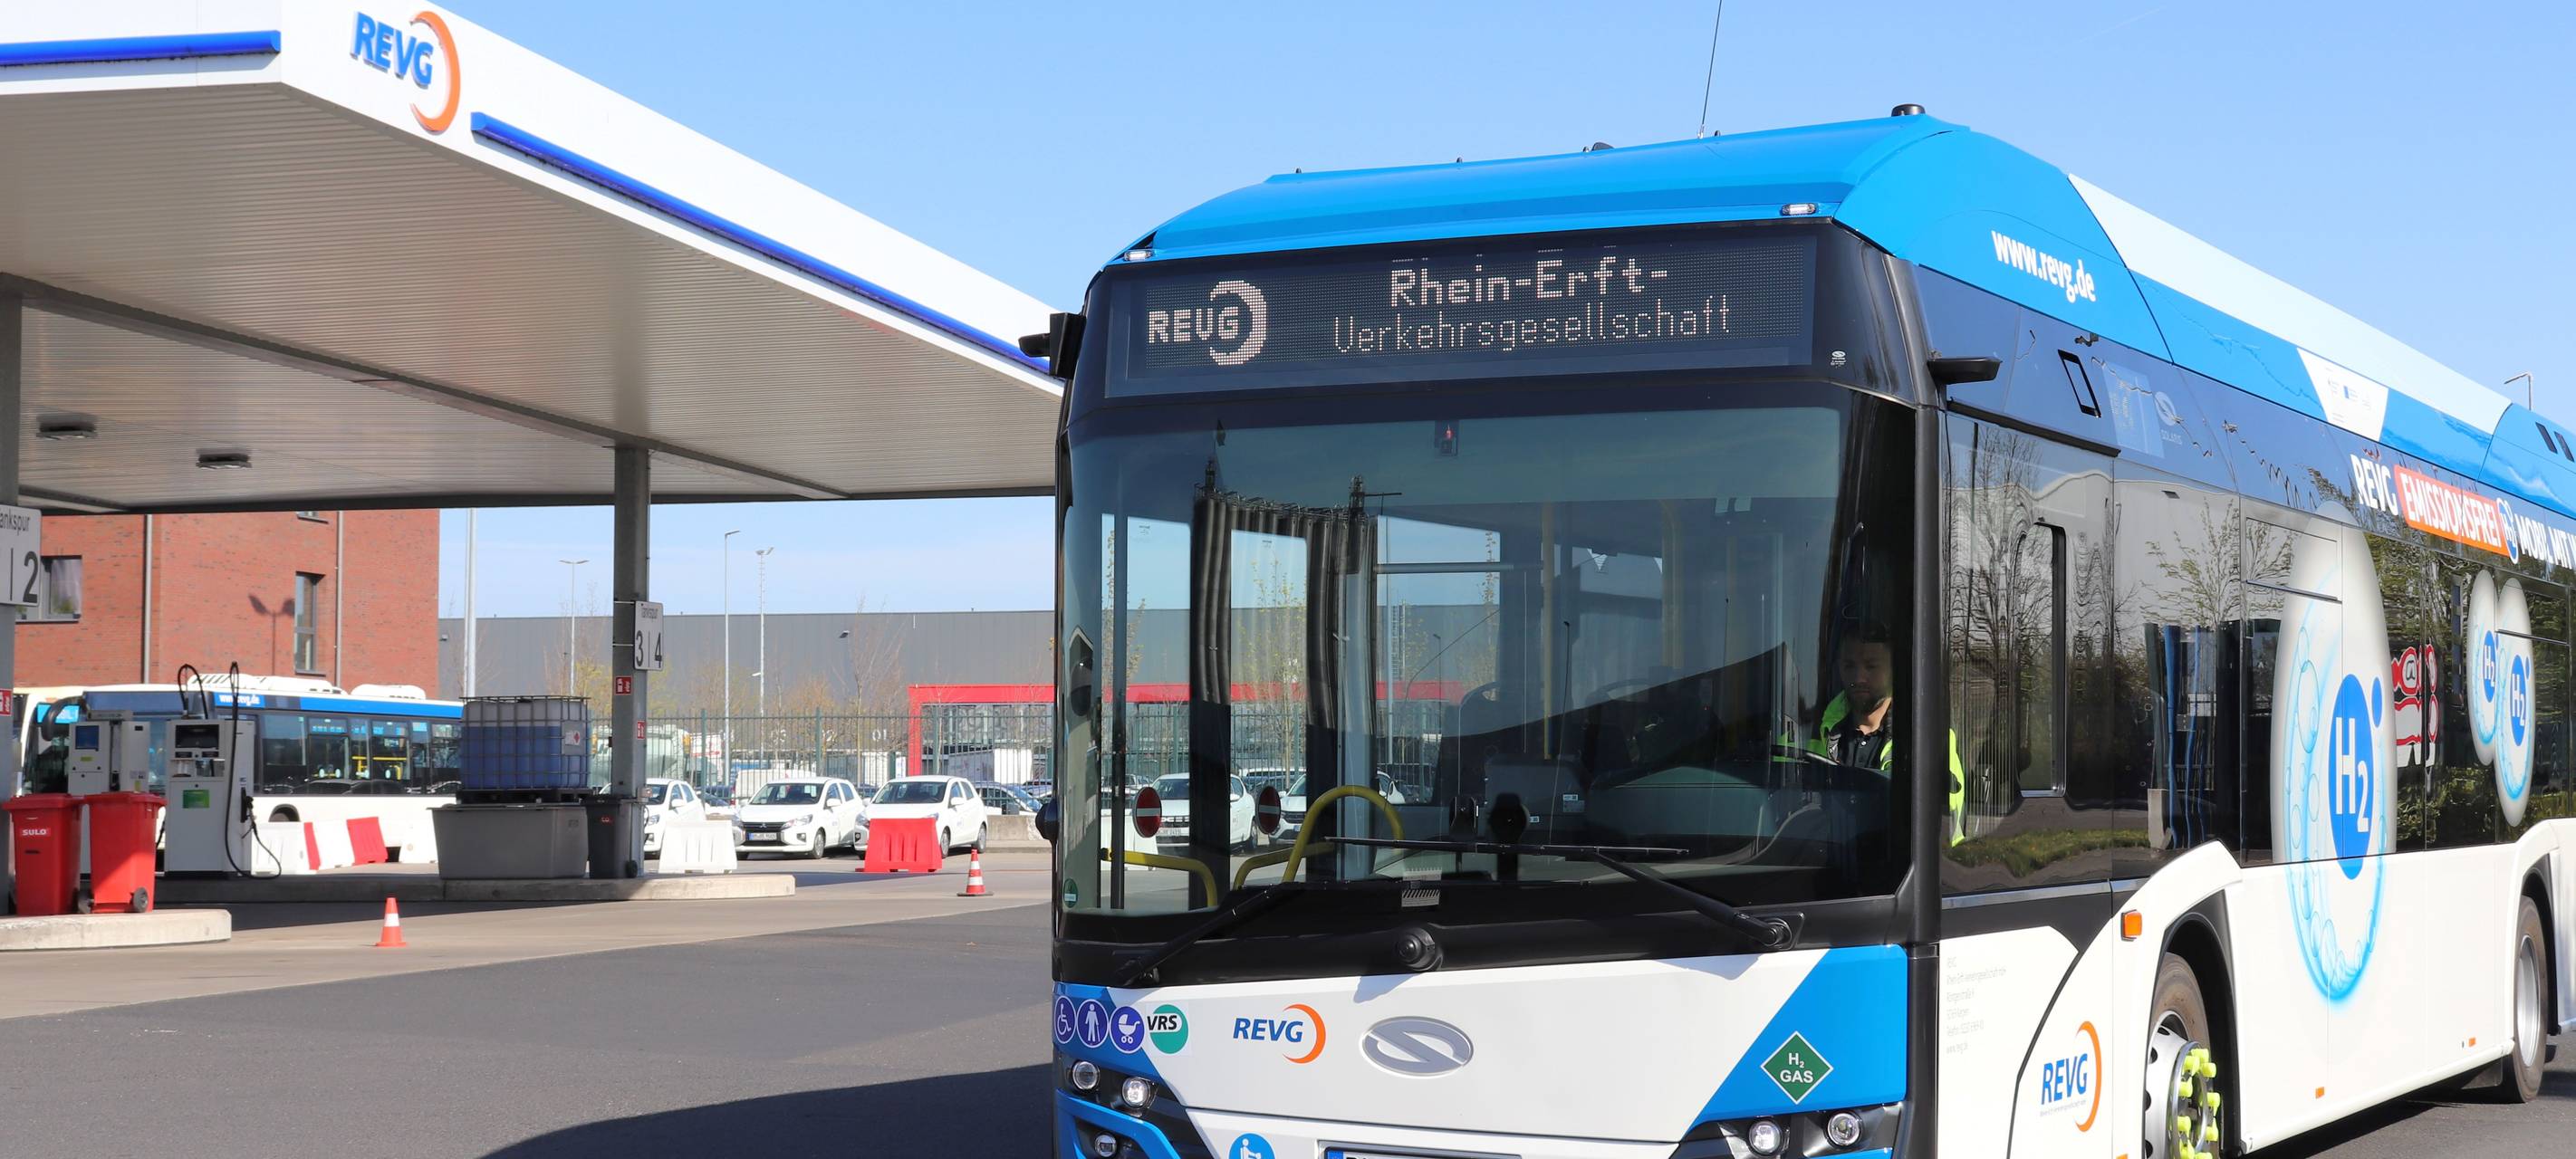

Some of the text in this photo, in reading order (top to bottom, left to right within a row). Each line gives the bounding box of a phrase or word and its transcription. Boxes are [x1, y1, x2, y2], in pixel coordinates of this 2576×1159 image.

[351, 11, 434, 88] REVG
[1391, 254, 1668, 307] Rhein-Erft-
[1991, 230, 2096, 303] www.revg.de
[1149, 306, 1239, 343] REVG
[1333, 294, 1730, 353] Verkehrsgesellschaft
[0, 508, 30, 536] ankspur
[2350, 454, 2398, 516] REVG
[2399, 472, 2502, 548] EMISSIONSFREI
[2514, 513, 2553, 563] MOBIL
[2548, 526, 2572, 570] MIT
[23, 551, 39, 604] 2
[636, 629, 662, 668] 3 4
[2335, 717, 2369, 833] H2
[22, 829, 47, 837] SULO
[1147, 1014, 1177, 1031] VRS
[1233, 1018, 1304, 1043] REVG
[1780, 1069, 1814, 1084] GAS
[1788, 1052, 1805, 1068] H2
[2041, 1053, 2088, 1106] REVG
